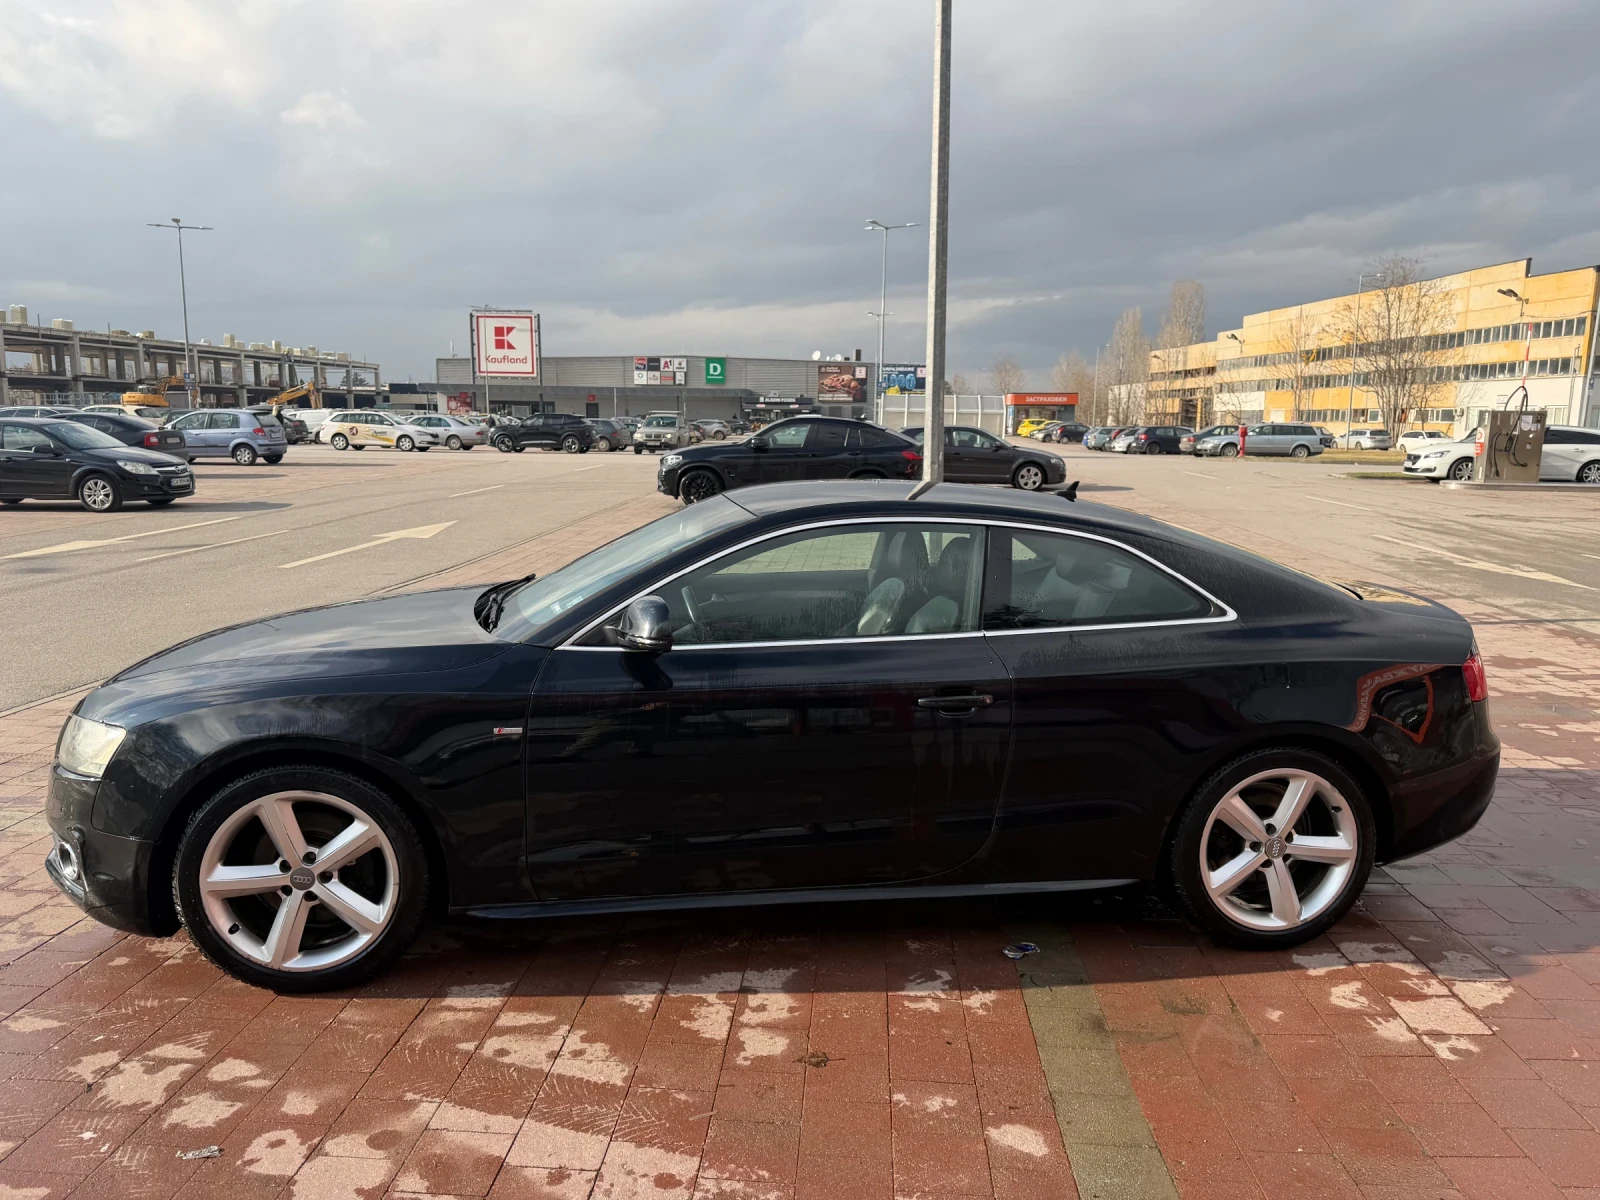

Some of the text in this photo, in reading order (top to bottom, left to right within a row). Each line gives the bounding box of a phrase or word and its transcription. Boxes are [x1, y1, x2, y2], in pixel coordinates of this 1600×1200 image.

[494, 326, 516, 350] K
[485, 355, 527, 364] Kaufland
[662, 359, 672, 370] A1
[709, 363, 721, 375] D
